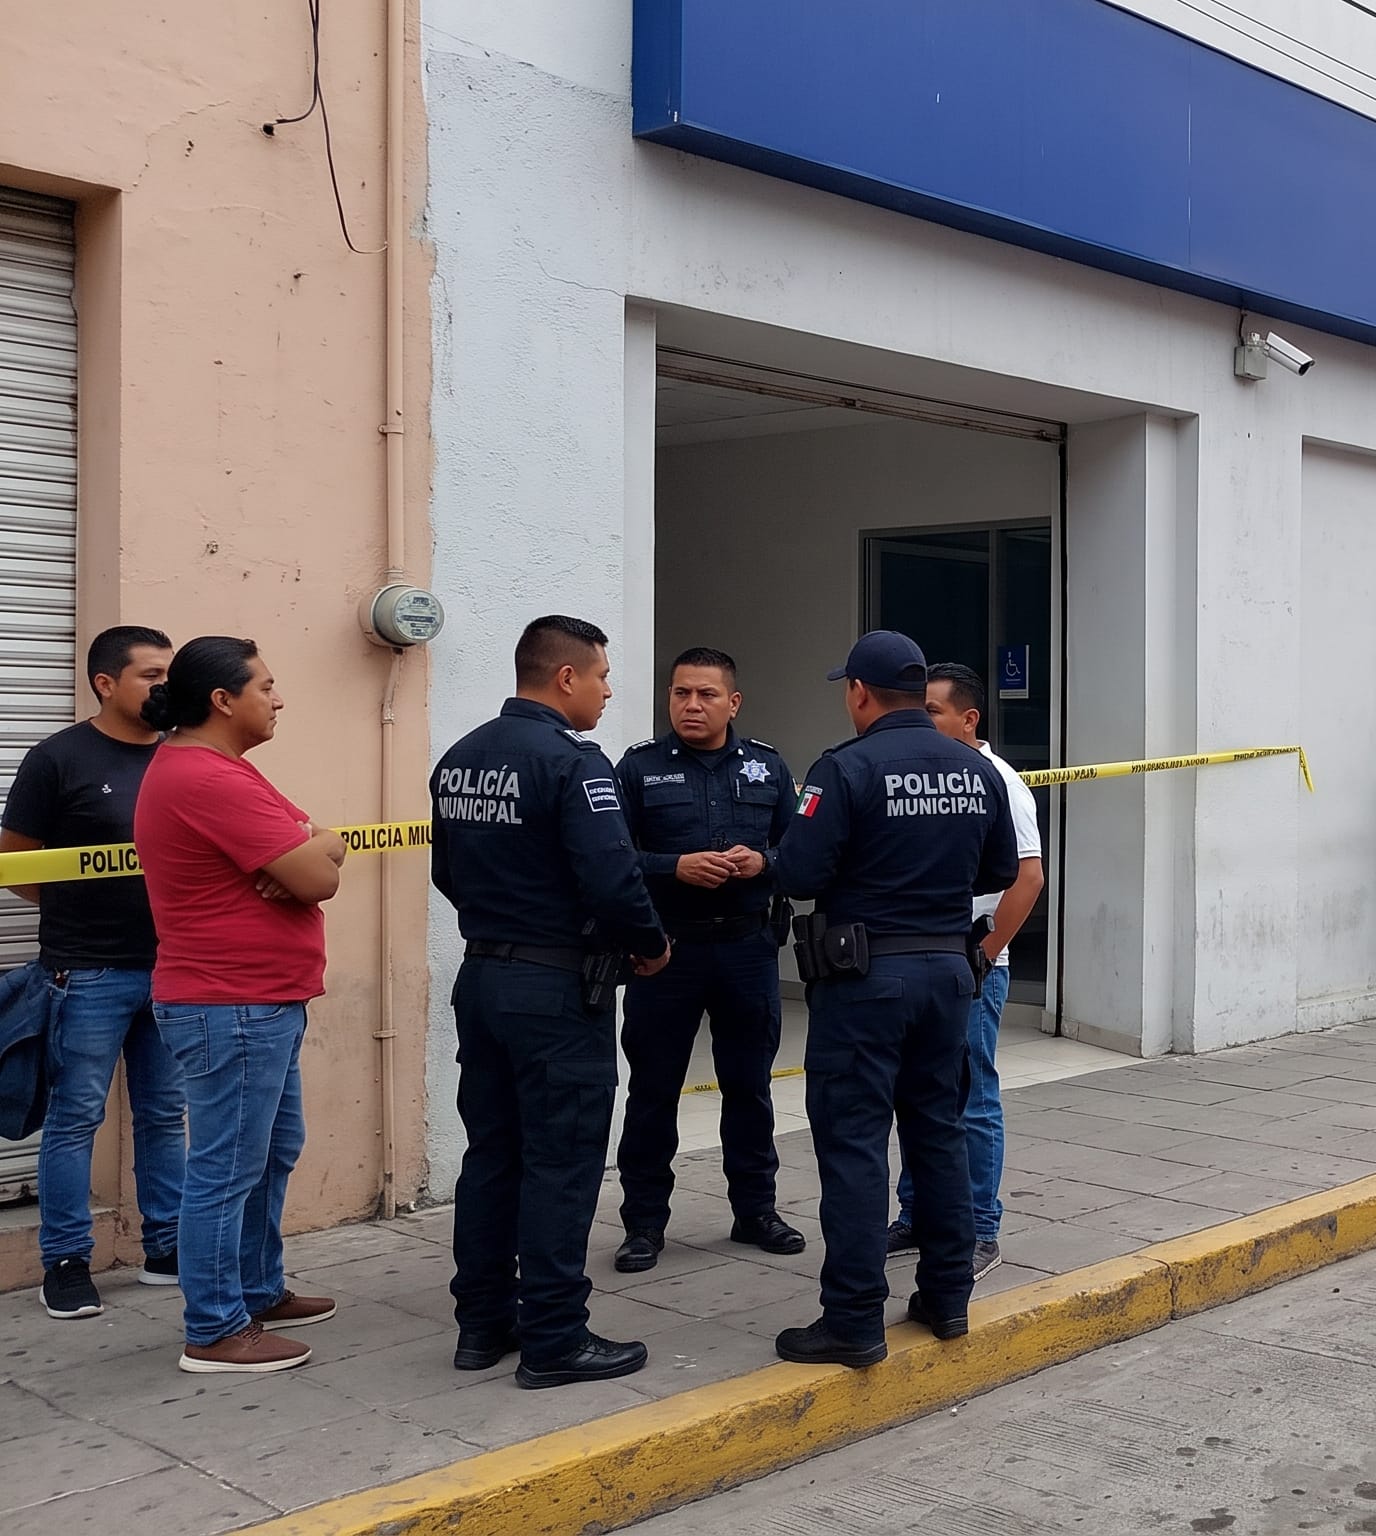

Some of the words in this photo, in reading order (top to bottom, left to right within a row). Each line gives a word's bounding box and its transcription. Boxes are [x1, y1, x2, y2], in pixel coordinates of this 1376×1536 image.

[438, 764, 521, 798] POLICÍA
[884, 768, 987, 797] POLICÍA
[438, 796, 523, 825] MUNICIPAL
[886, 797, 987, 817] MUNICIPAL
[79, 847, 143, 874] POLIC
